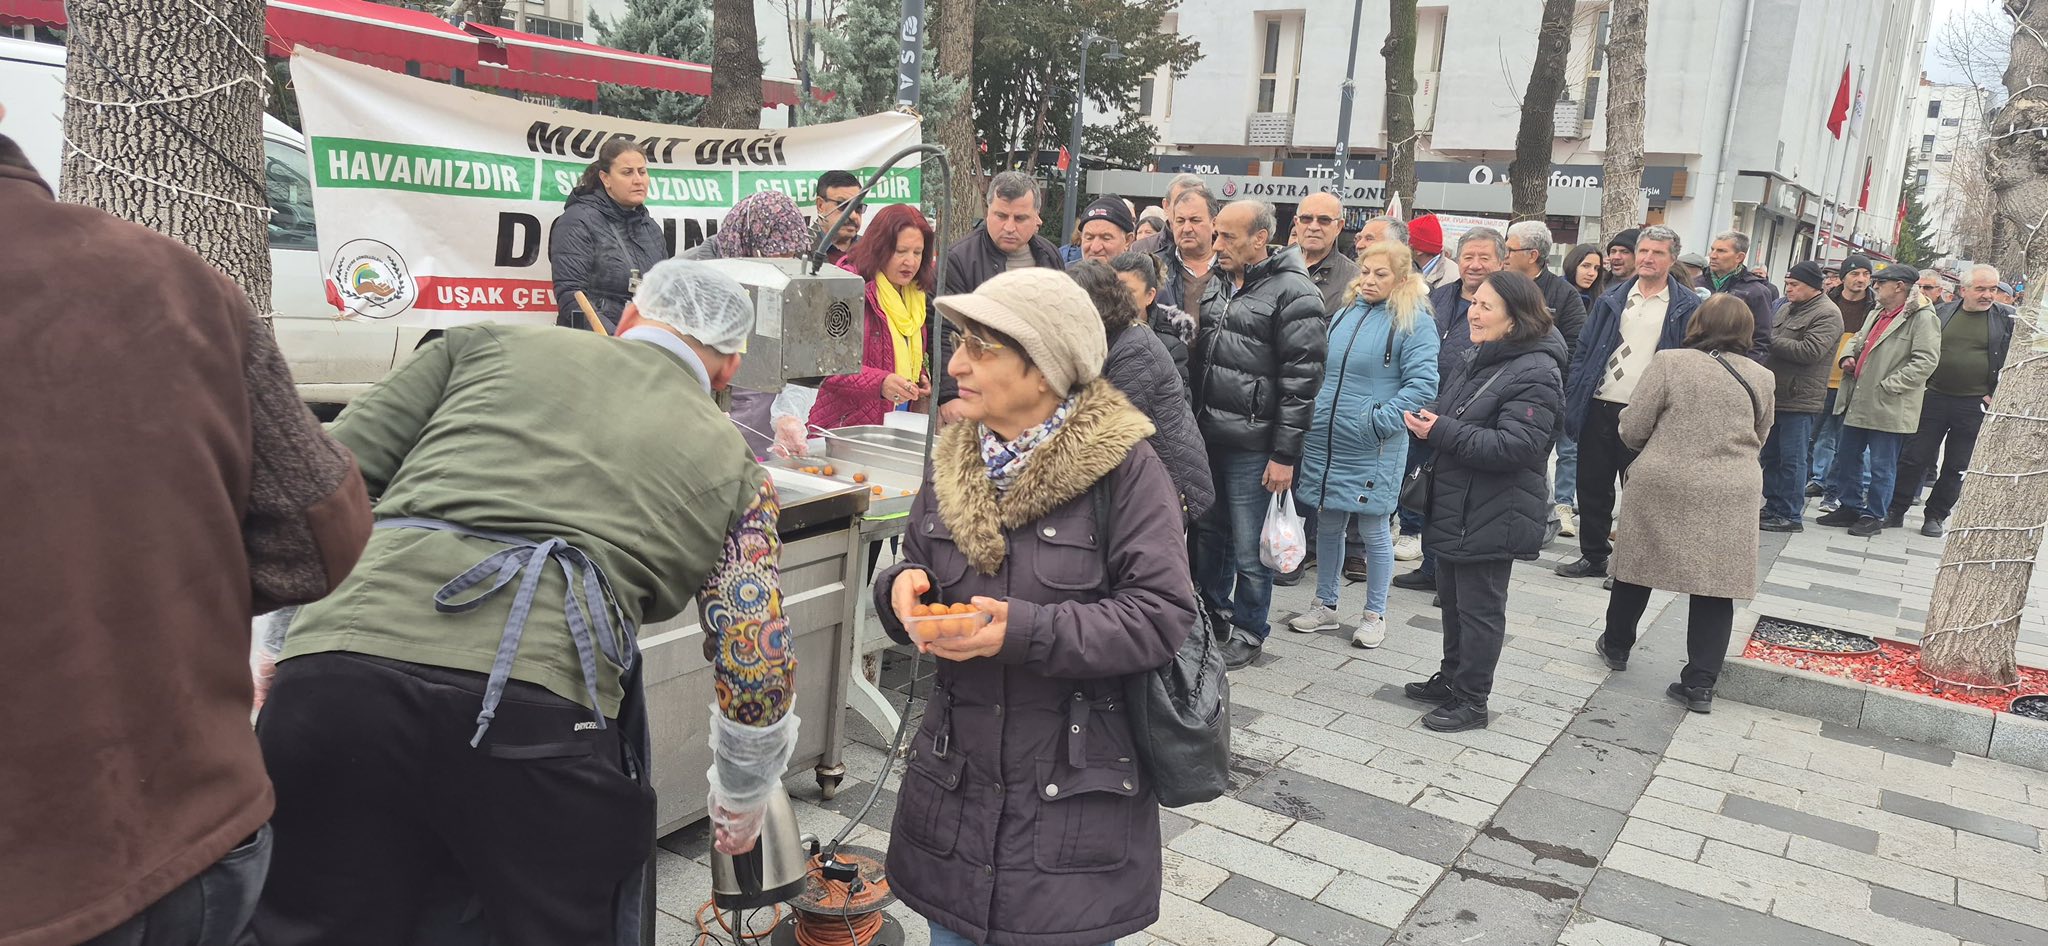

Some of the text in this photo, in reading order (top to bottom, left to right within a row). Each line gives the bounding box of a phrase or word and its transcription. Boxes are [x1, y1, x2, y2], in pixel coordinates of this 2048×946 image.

[694, 130, 788, 166] DAĞI
[328, 149, 522, 193] HAVAMIZDIR
[1305, 164, 1355, 180] TİTN
[1501, 171, 1598, 188] vfone
[555, 170, 724, 202] SUZDUR
[755, 170, 912, 202] GELECİZDİR
[1243, 183, 1387, 200] LOSTRA SLONU
[437, 286, 559, 309] UŞAK ÇEV
